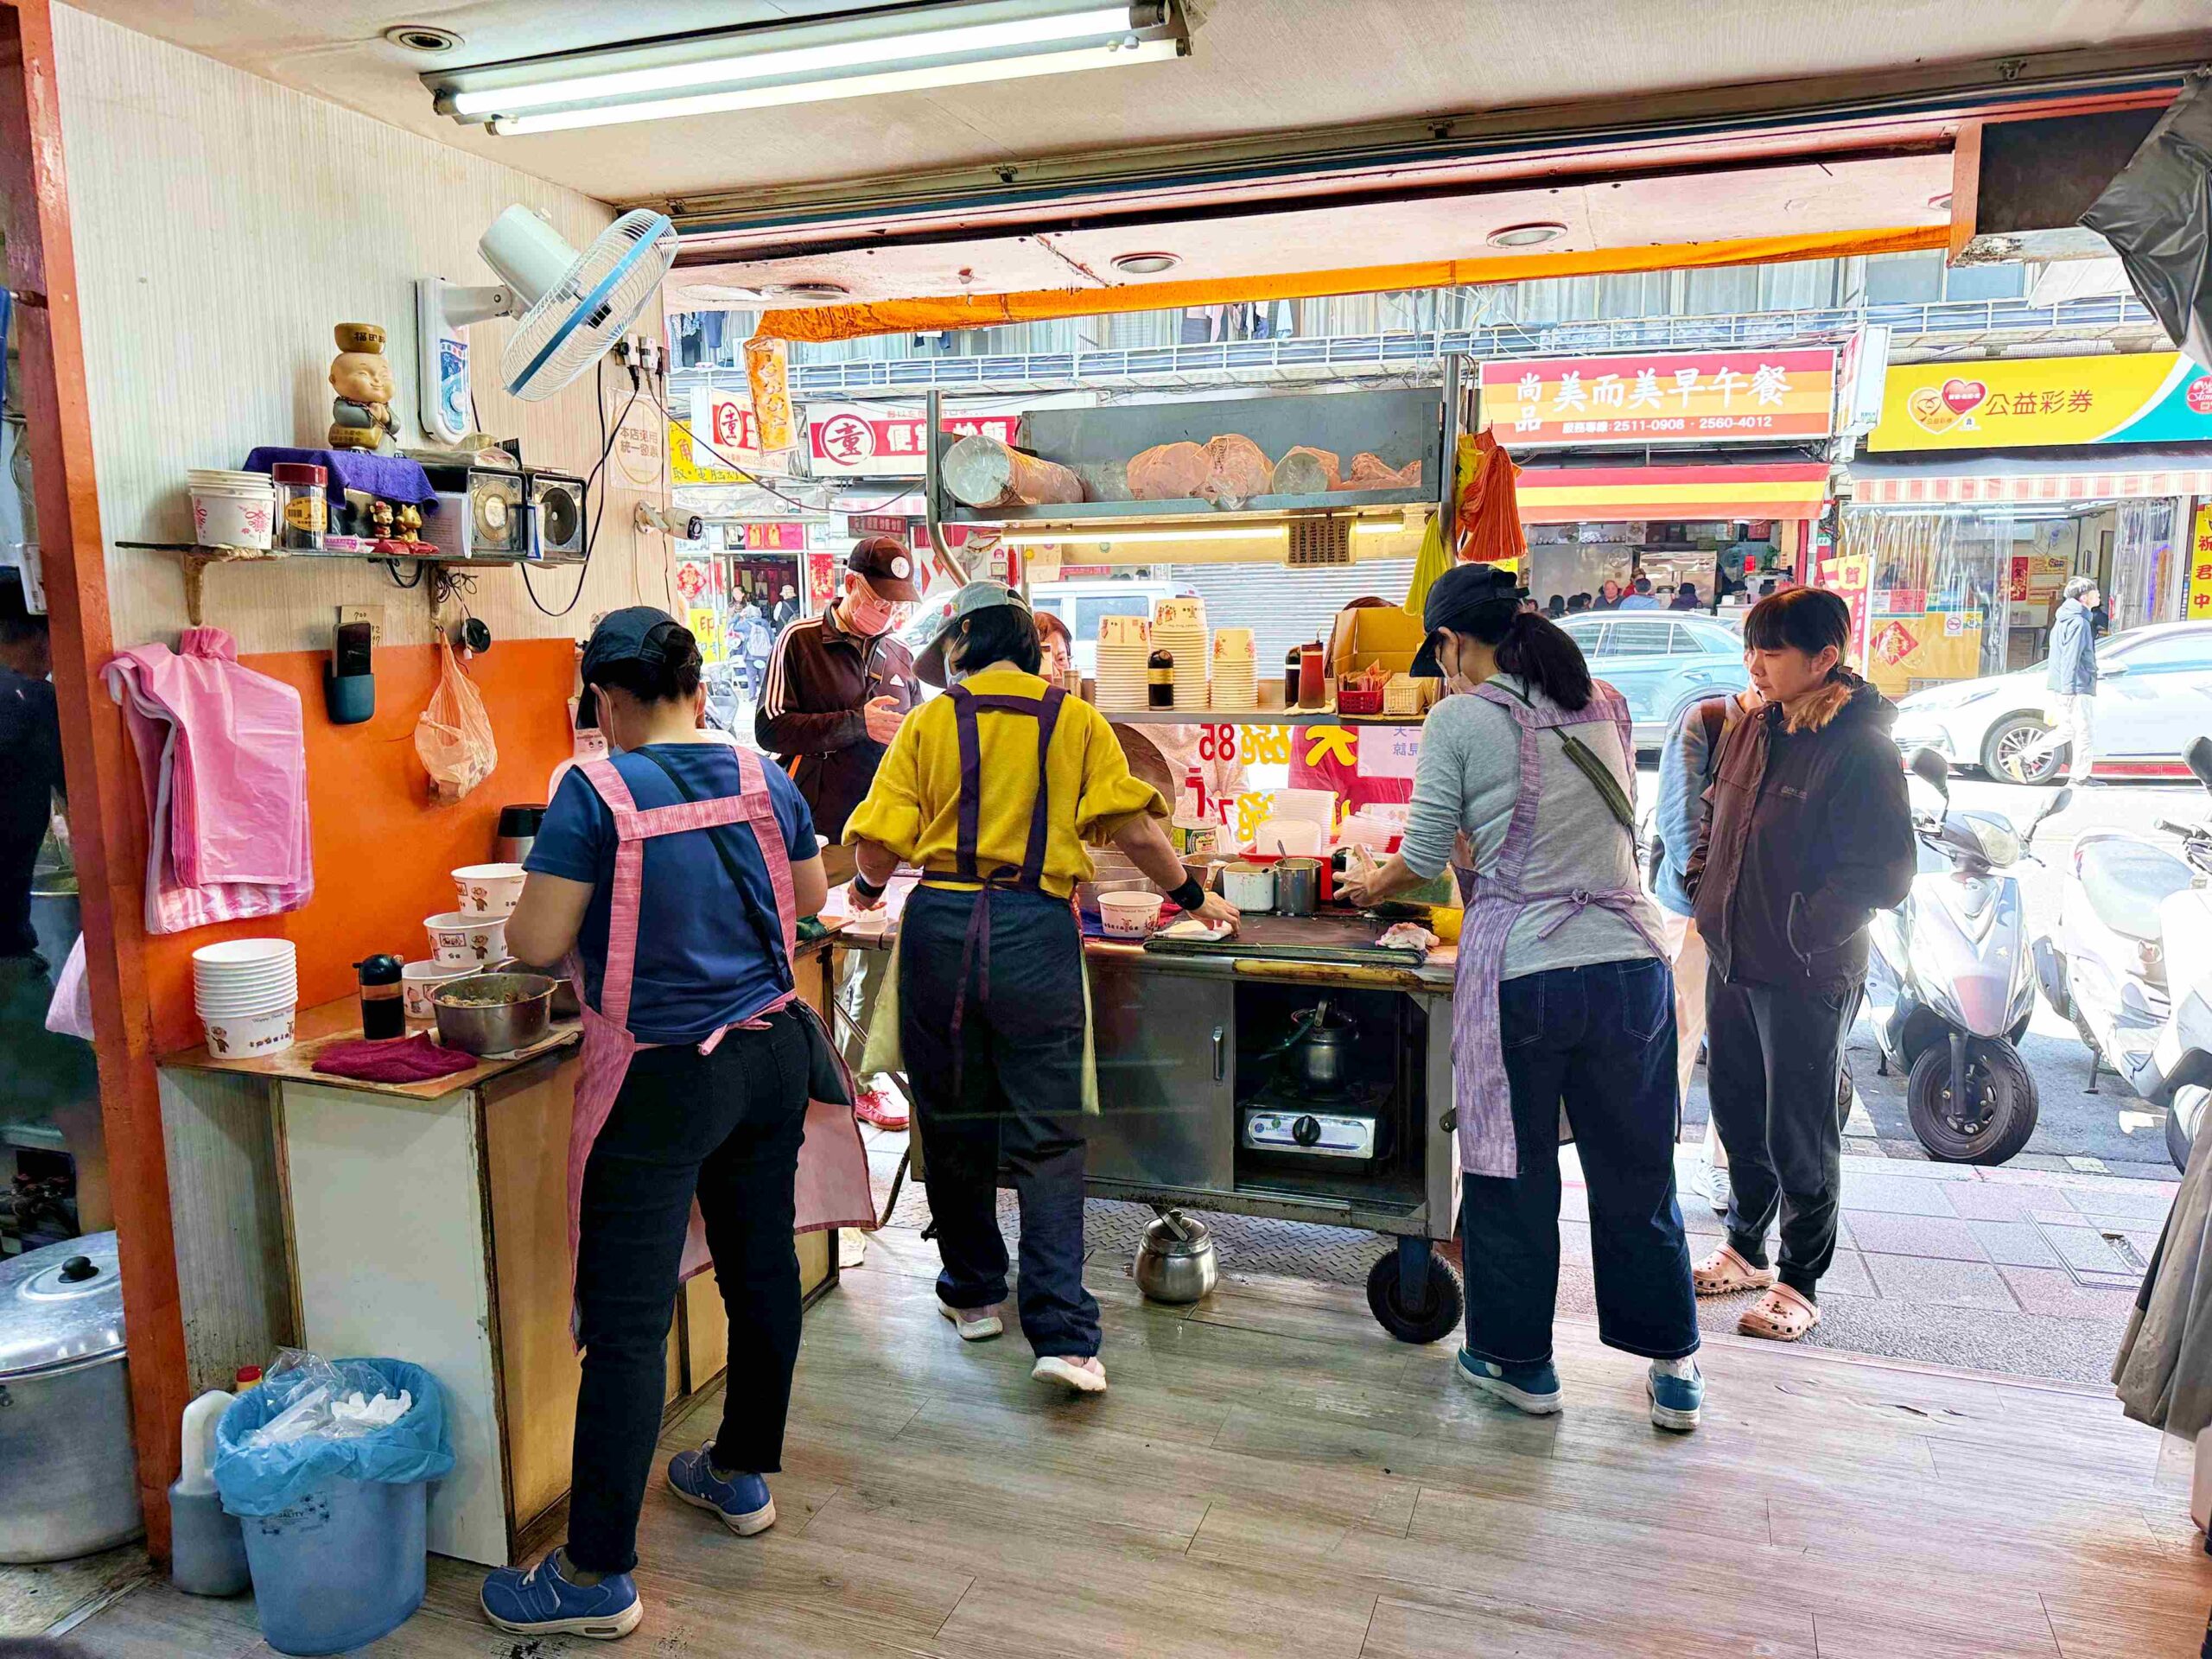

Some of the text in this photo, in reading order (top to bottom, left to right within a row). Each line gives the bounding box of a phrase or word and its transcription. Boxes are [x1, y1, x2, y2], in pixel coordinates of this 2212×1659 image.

[1514, 372, 1542, 433] 尚品
[1552, 363, 1793, 413] 美而美早午餐
[1985, 389, 2094, 416] 公益彩券
[828, 422, 864, 458] 童
[1699, 416, 1773, 429] 2560-4012
